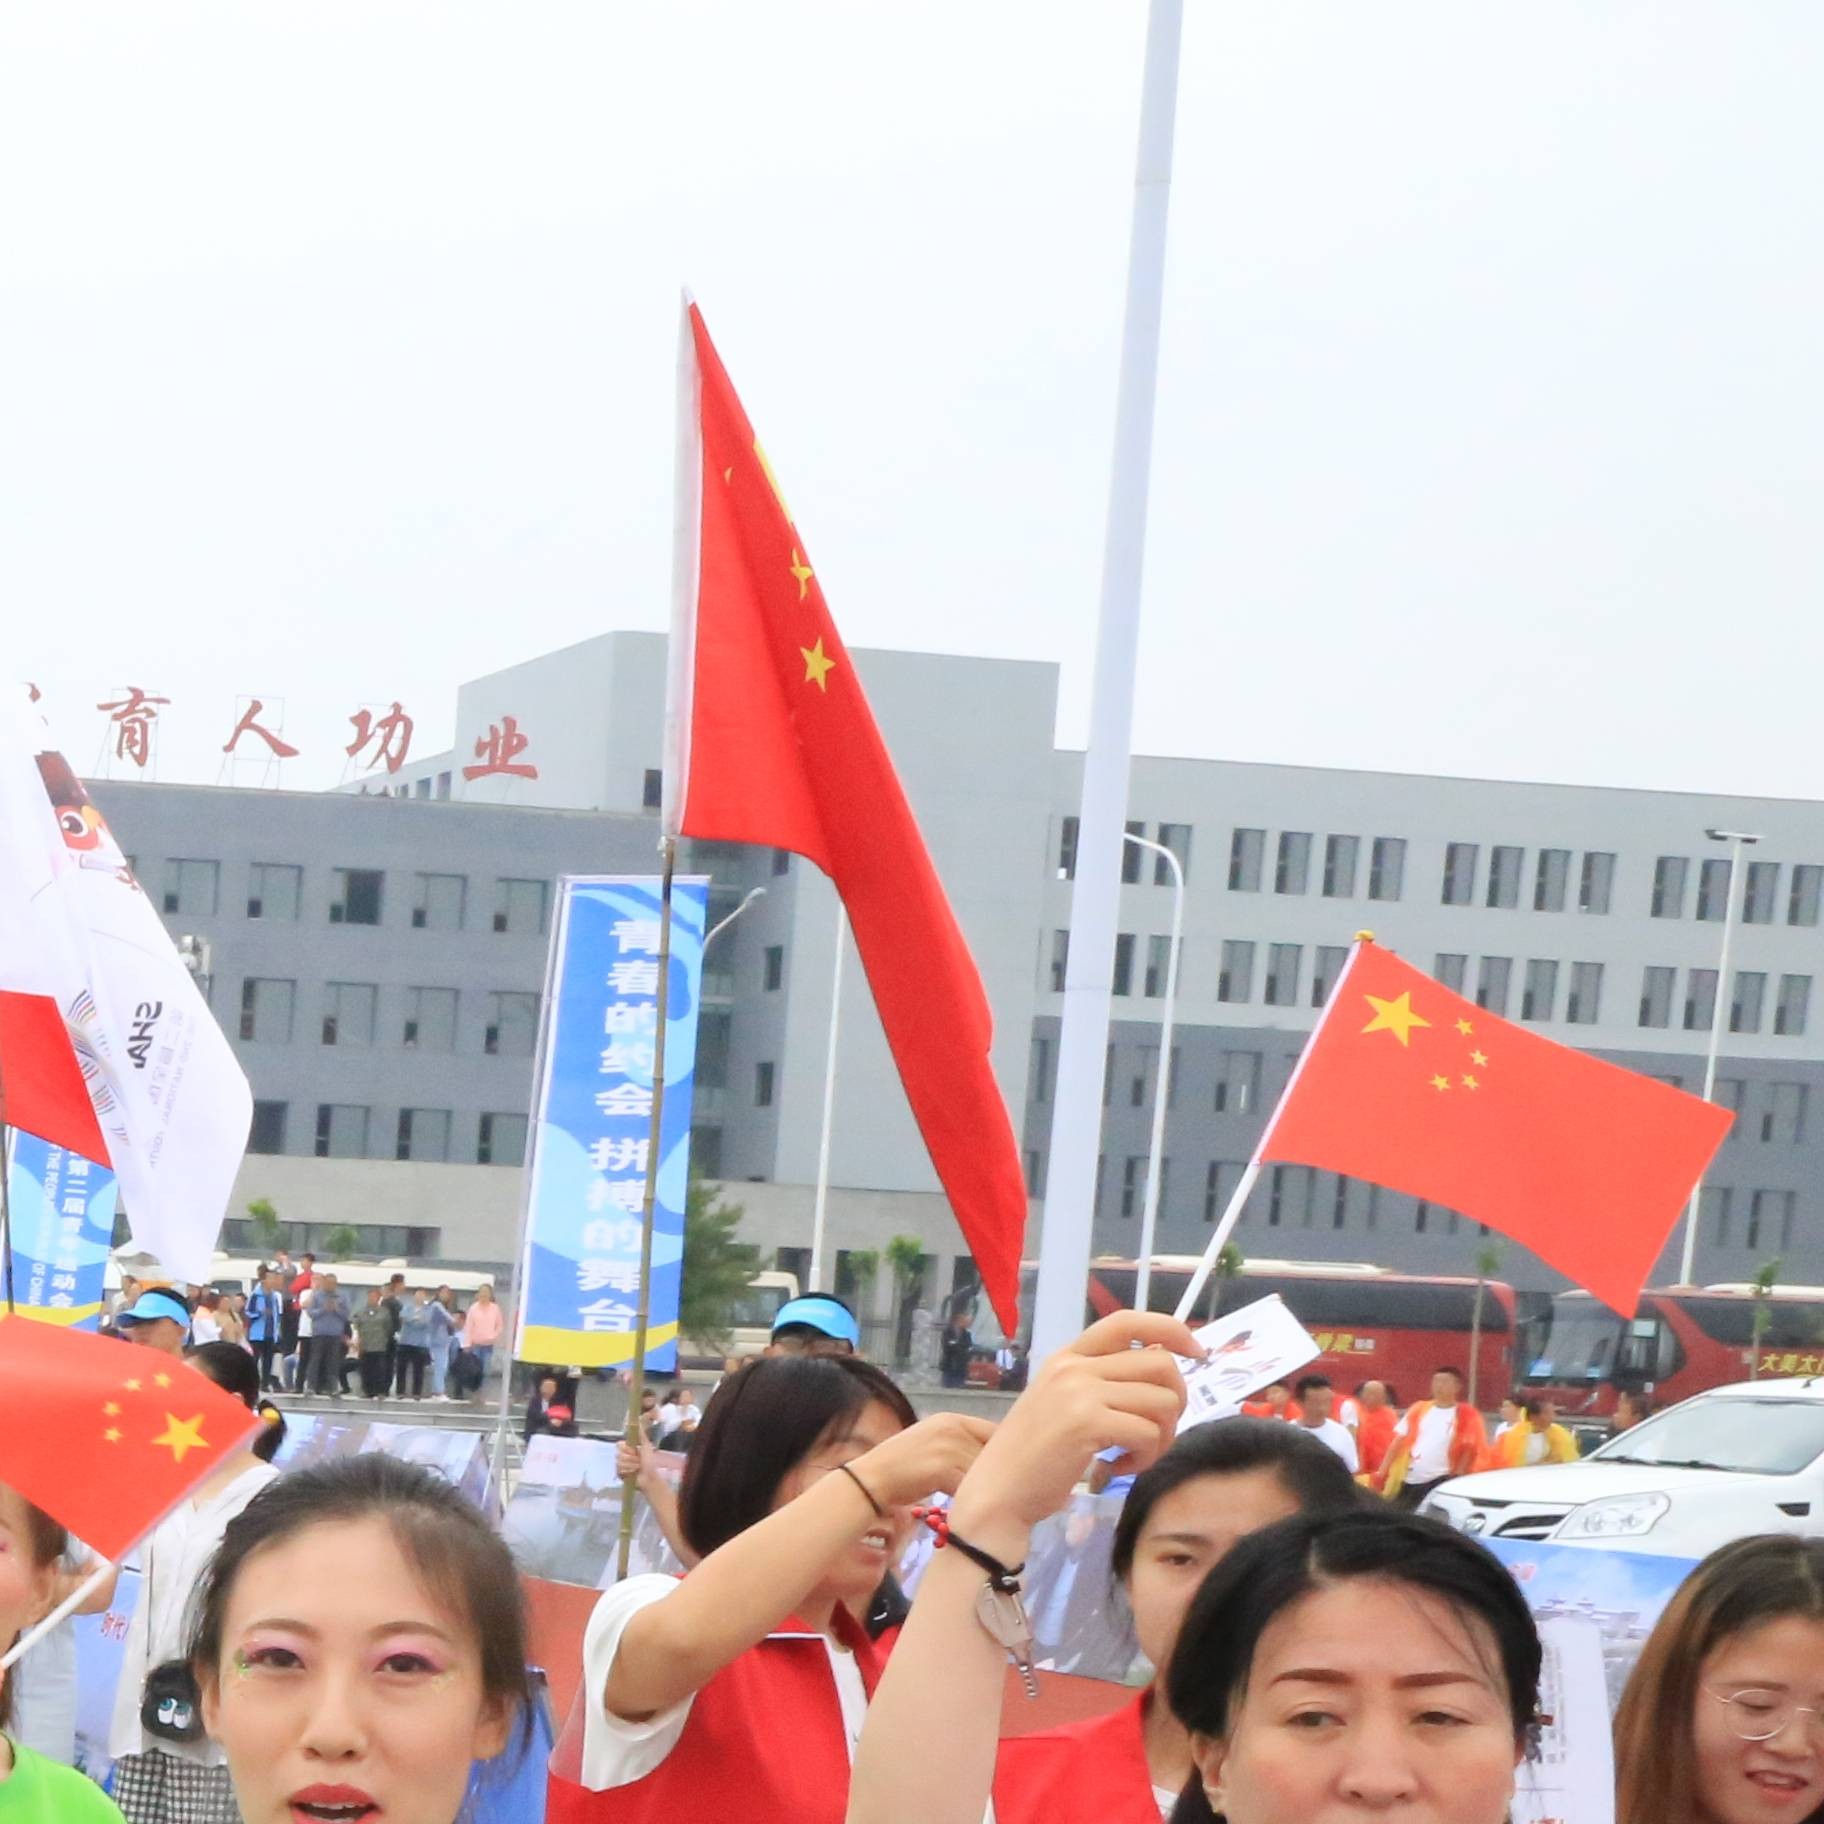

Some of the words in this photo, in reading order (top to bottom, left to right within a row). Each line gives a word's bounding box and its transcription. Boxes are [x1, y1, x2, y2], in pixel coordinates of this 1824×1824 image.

[24, 682, 539, 782] 育人功业
[593, 918, 661, 1118] 青春的约会
[576, 1137, 651, 1334] 拼搏的舞台
